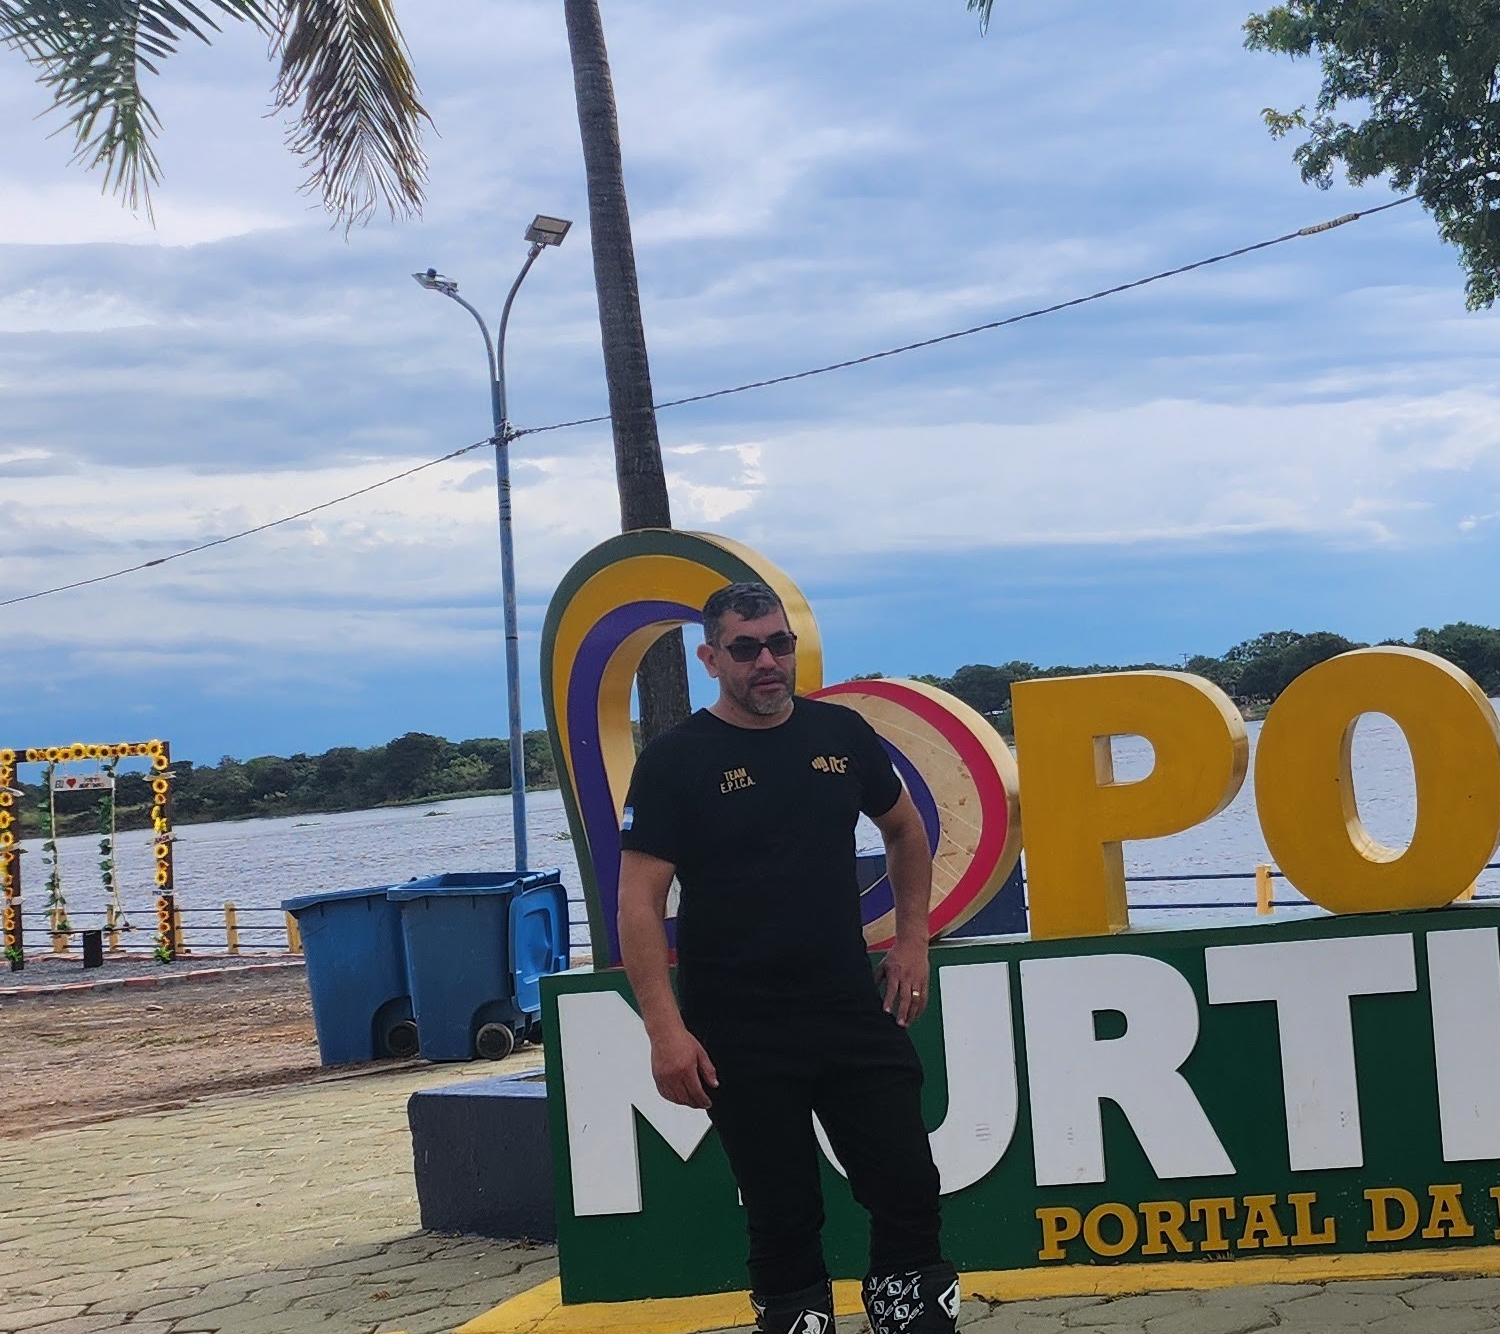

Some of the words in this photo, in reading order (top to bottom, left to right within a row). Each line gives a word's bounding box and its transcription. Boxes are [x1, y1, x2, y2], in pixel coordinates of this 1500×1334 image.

[724, 767, 747, 782] TEAM
[720, 777, 756, 794] E.P.I.C.A.
[1035, 1192, 1336, 1260] PORTAL
[1363, 1183, 1474, 1243] DA
